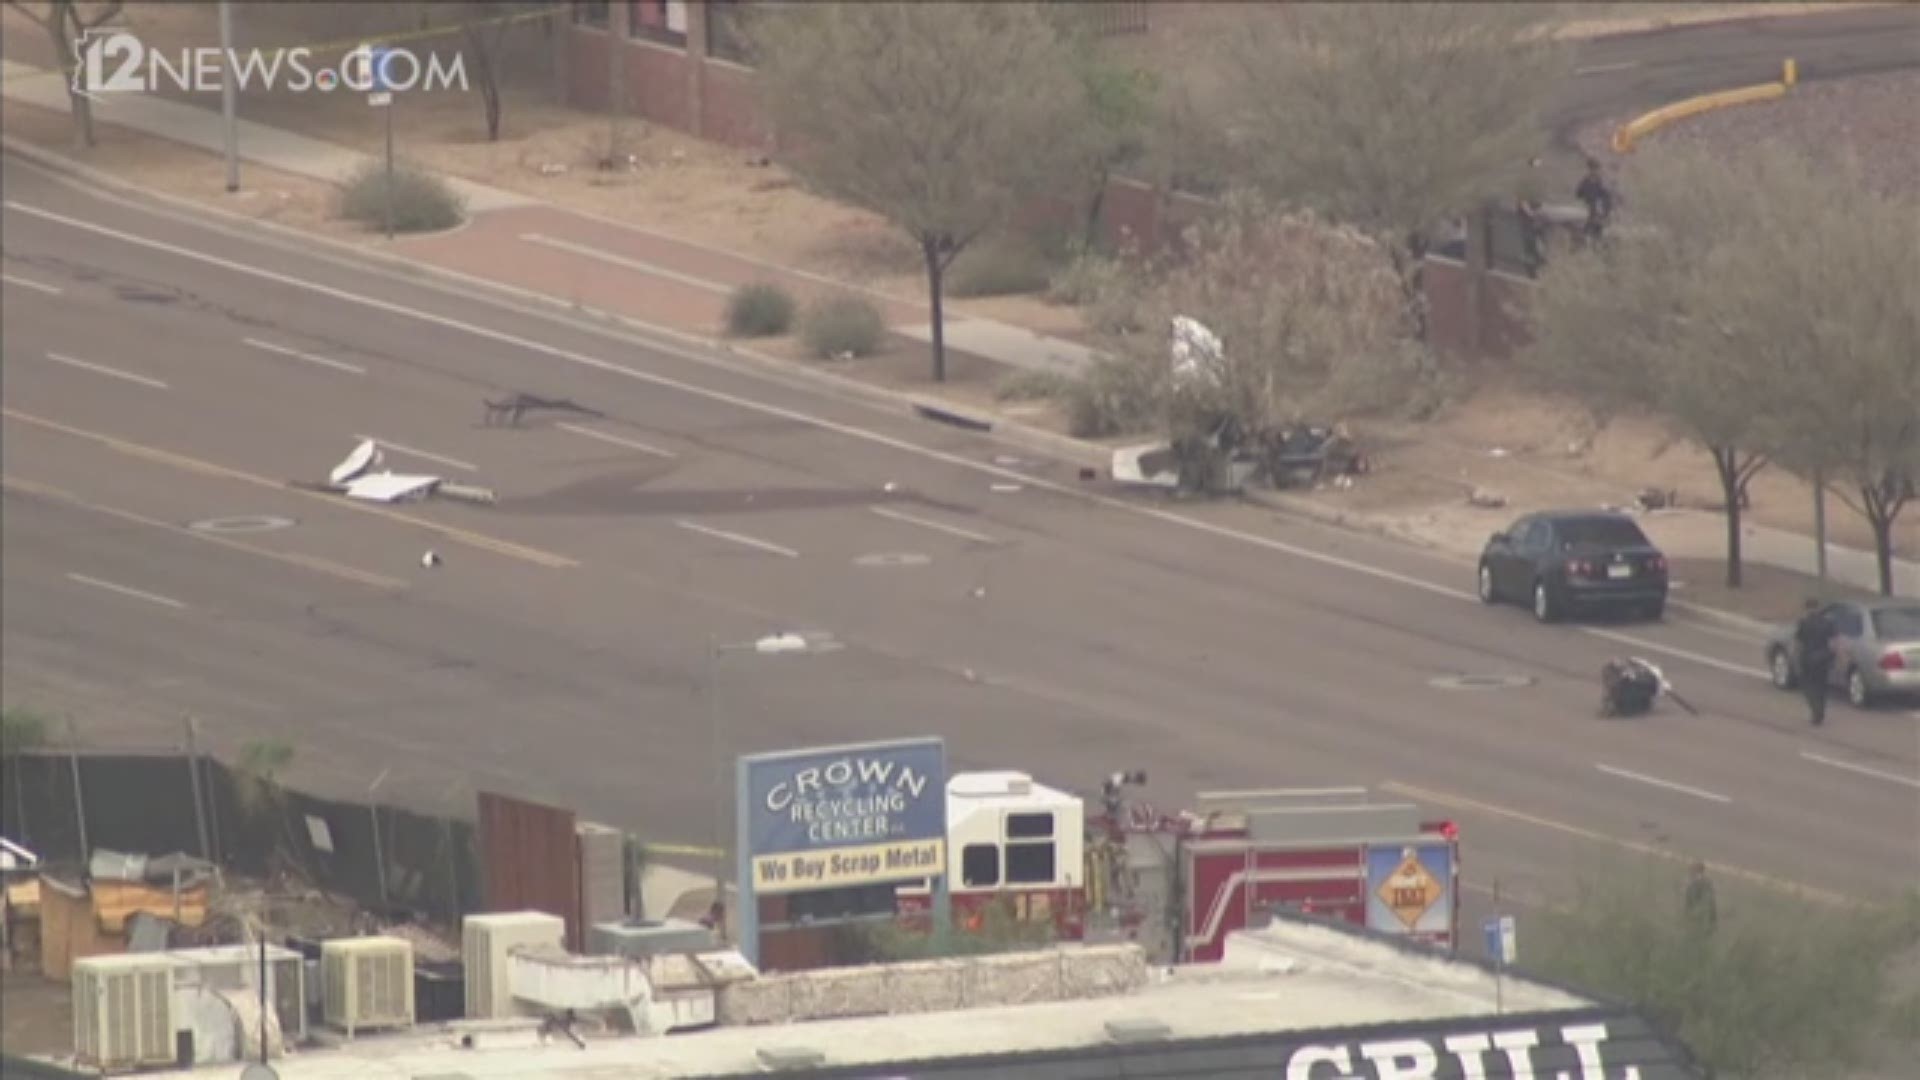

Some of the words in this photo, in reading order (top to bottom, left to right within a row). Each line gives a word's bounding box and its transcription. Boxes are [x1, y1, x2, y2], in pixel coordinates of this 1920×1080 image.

[767, 758, 926, 812] CROWN
[791, 792, 905, 823] RECYCLING
[809, 815, 889, 841] CENTER
[759, 859, 787, 881] We
[792, 857, 825, 879] Buy
[830, 852, 880, 875] Scrap
[886, 845, 937, 868] Metal
